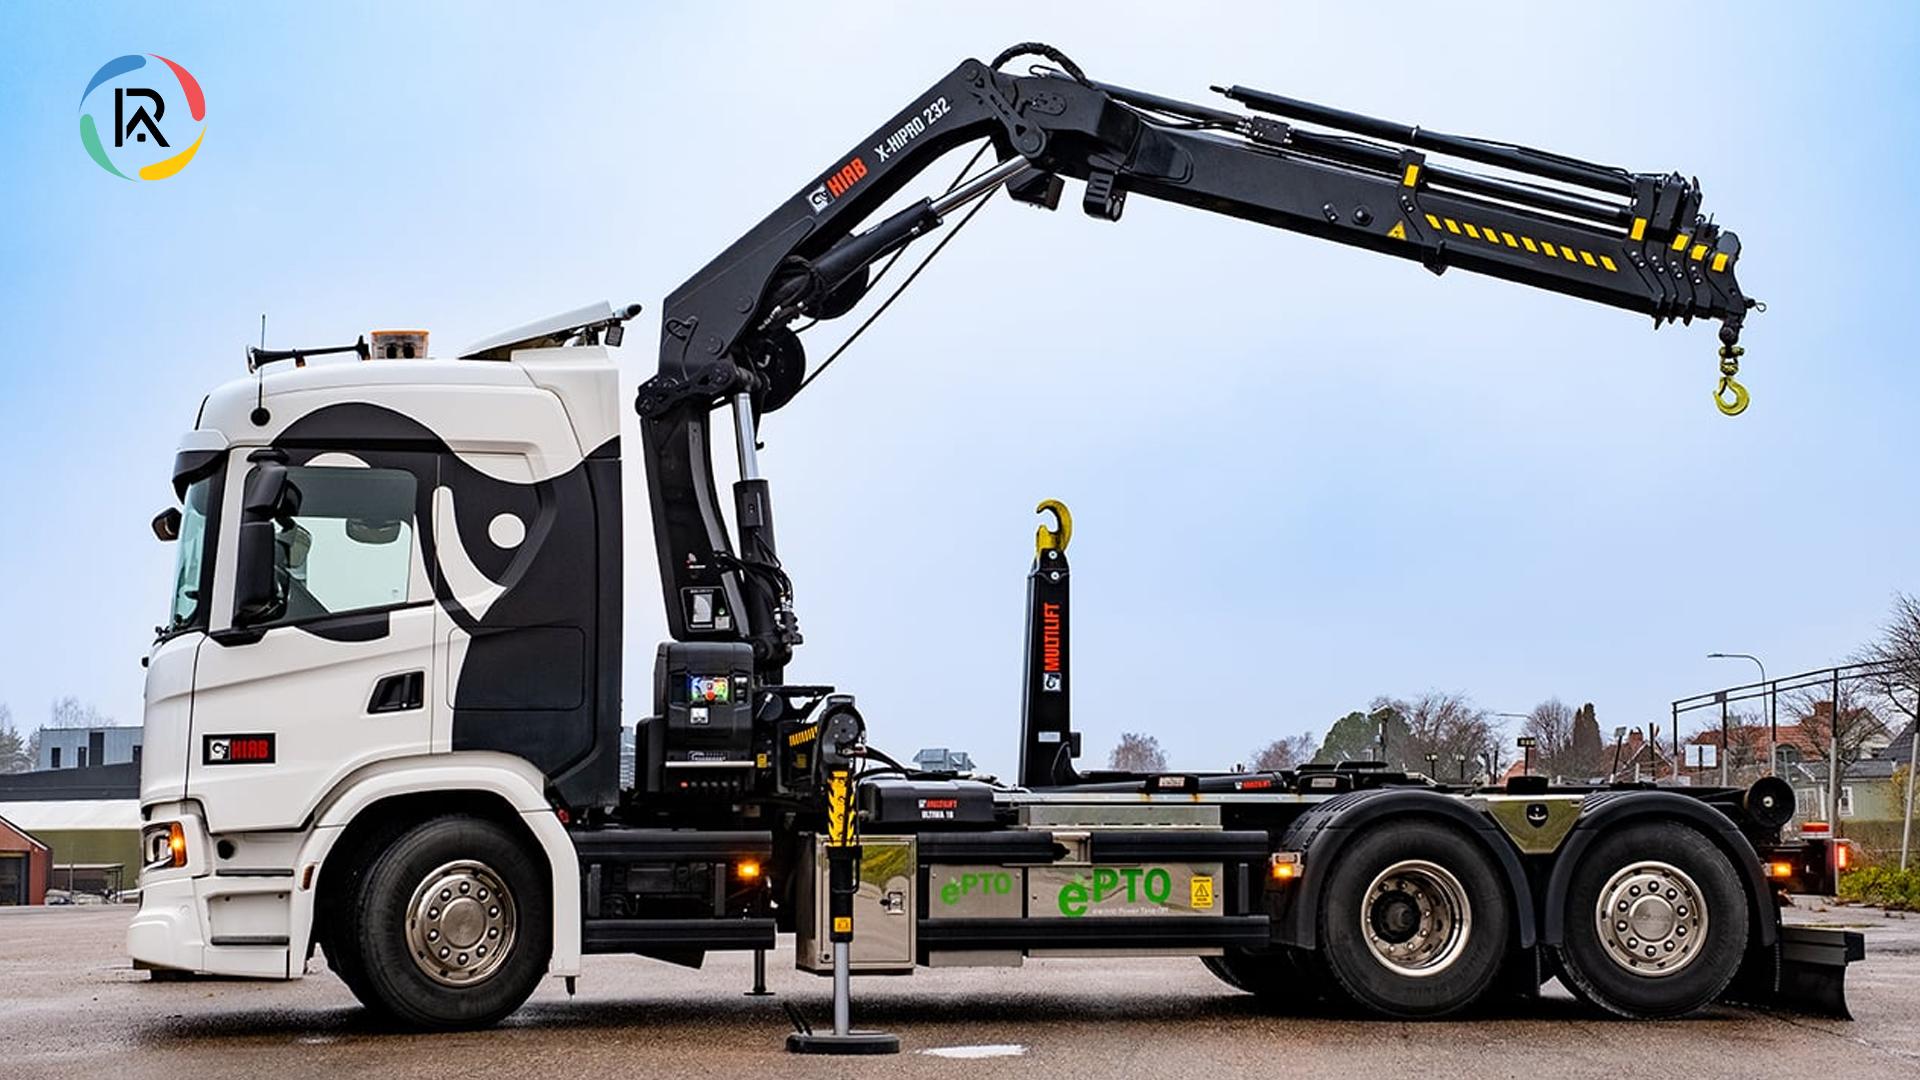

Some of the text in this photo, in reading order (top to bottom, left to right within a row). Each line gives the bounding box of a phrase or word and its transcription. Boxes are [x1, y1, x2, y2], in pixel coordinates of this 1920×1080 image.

[827, 97, 950, 198] HIAB X-HIPRO 232
[1043, 602, 1061, 672] MULTILIFT
[231, 739, 269, 759] HIAB
[941, 872, 1013, 905] ePTO
[1058, 867, 1172, 918] ePTO
